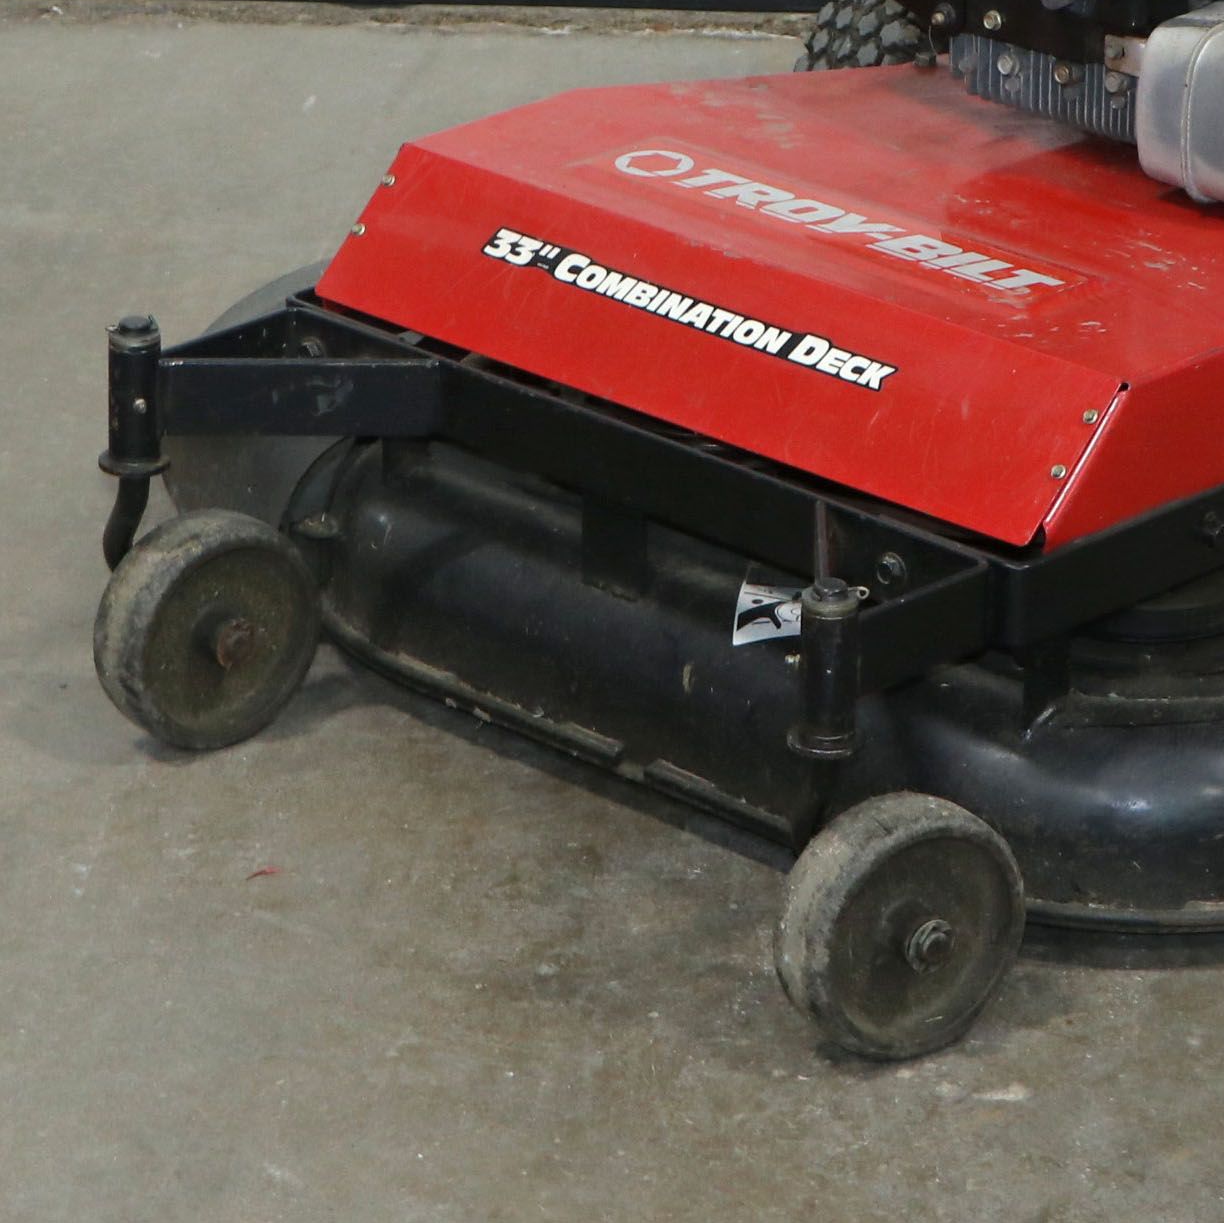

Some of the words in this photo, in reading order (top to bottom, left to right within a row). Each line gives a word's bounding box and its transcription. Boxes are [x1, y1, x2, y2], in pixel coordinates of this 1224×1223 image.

[673, 168, 1066, 292] TROY-BILT
[484, 228, 561, 266] 33"
[553, 253, 792, 356] COMBINATION
[788, 334, 896, 391] DECK
